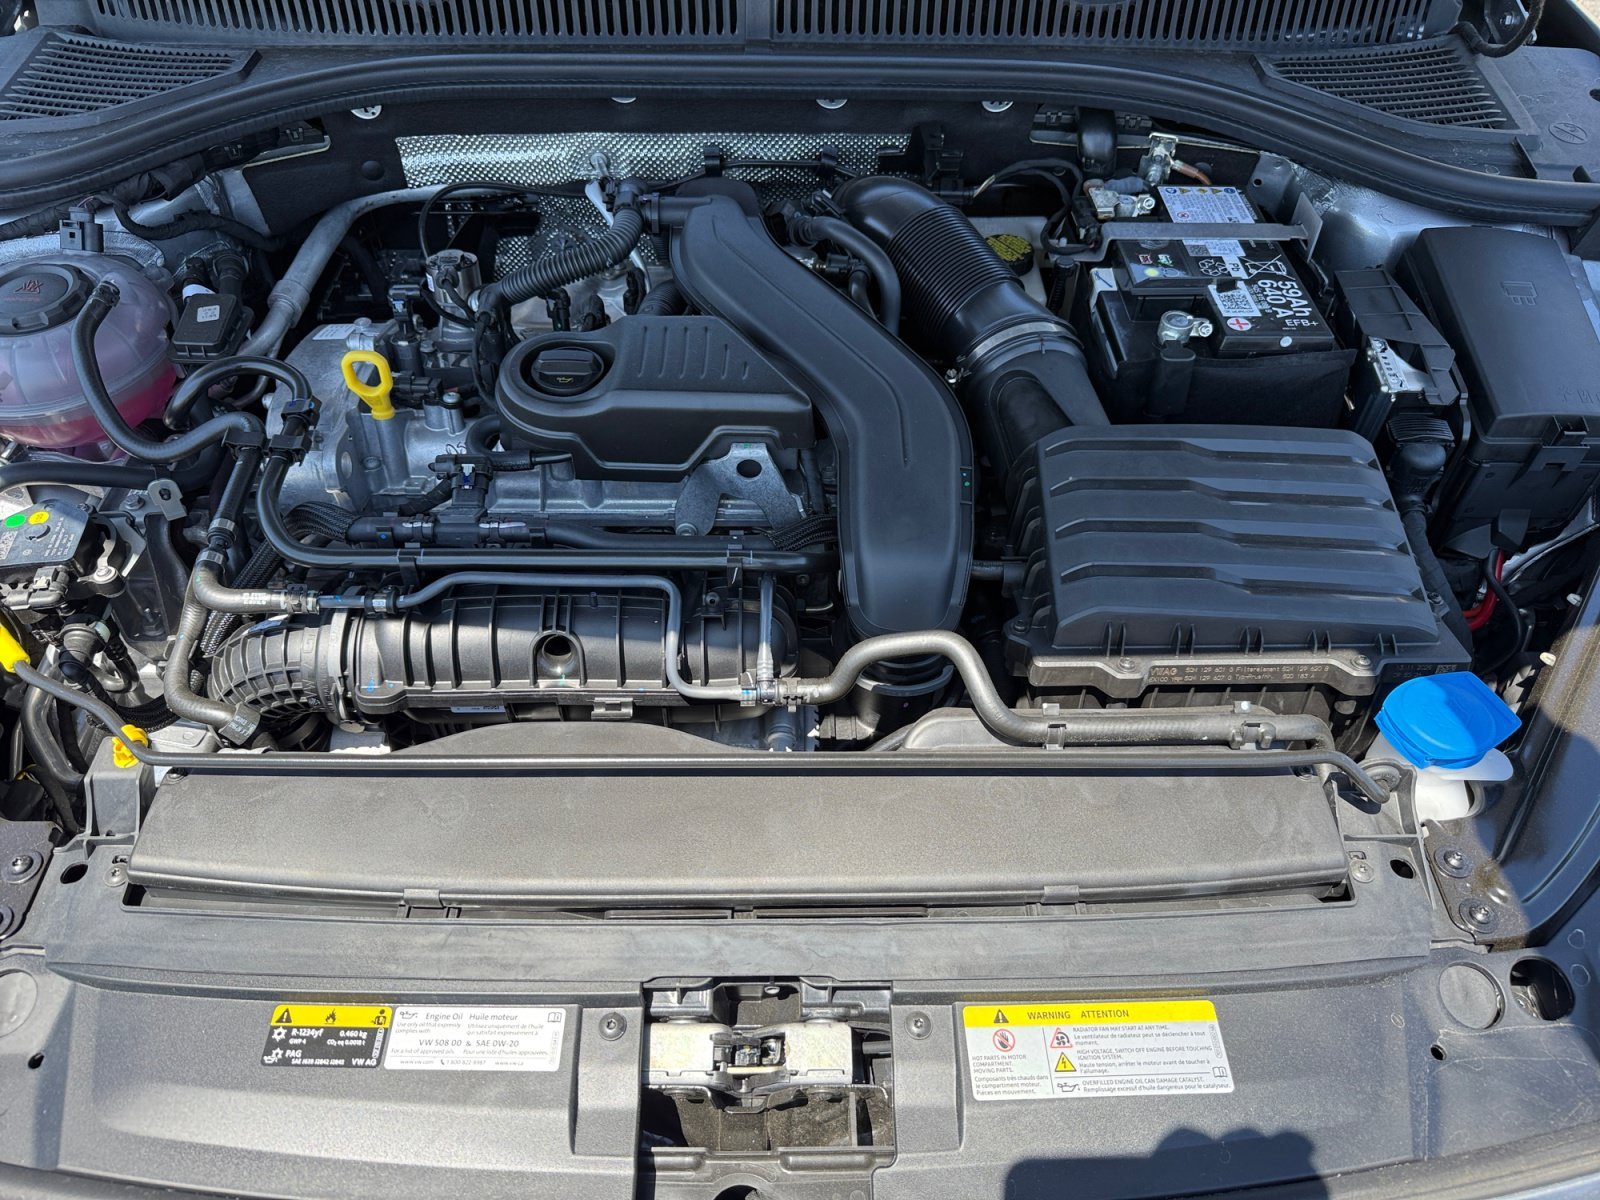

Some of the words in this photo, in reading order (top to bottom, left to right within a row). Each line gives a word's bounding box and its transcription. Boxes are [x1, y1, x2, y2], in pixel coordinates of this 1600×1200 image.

[1228, 262, 1240, 272] Pb
[1258, 279, 1287, 304] 640
[1278, 280, 1312, 317] 59Ah
[1272, 307, 1294, 318] A
[1285, 319, 1319, 327] EFB+
[425, 1012, 451, 1022] Engine
[452, 1012, 463, 1020] Oil
[469, 1012, 489, 1020] Huile
[1027, 1011, 1071, 1020] WARNING
[1081, 1009, 1129, 1019] ATTENTION
[291, 1028, 324, 1039] R-1234yf
[339, 1030, 358, 1038] 0.460
[358, 1030, 368, 1039] kg
[419, 1039, 433, 1047] VW
[435, 1039, 449, 1047] 508
[451, 1039, 462, 1047] 00
[285, 1049, 302, 1058] PAG
[351, 1058, 364, 1066] VW
[364, 1058, 377, 1066] AG
[981, 1082, 1020, 1090] compartiment
